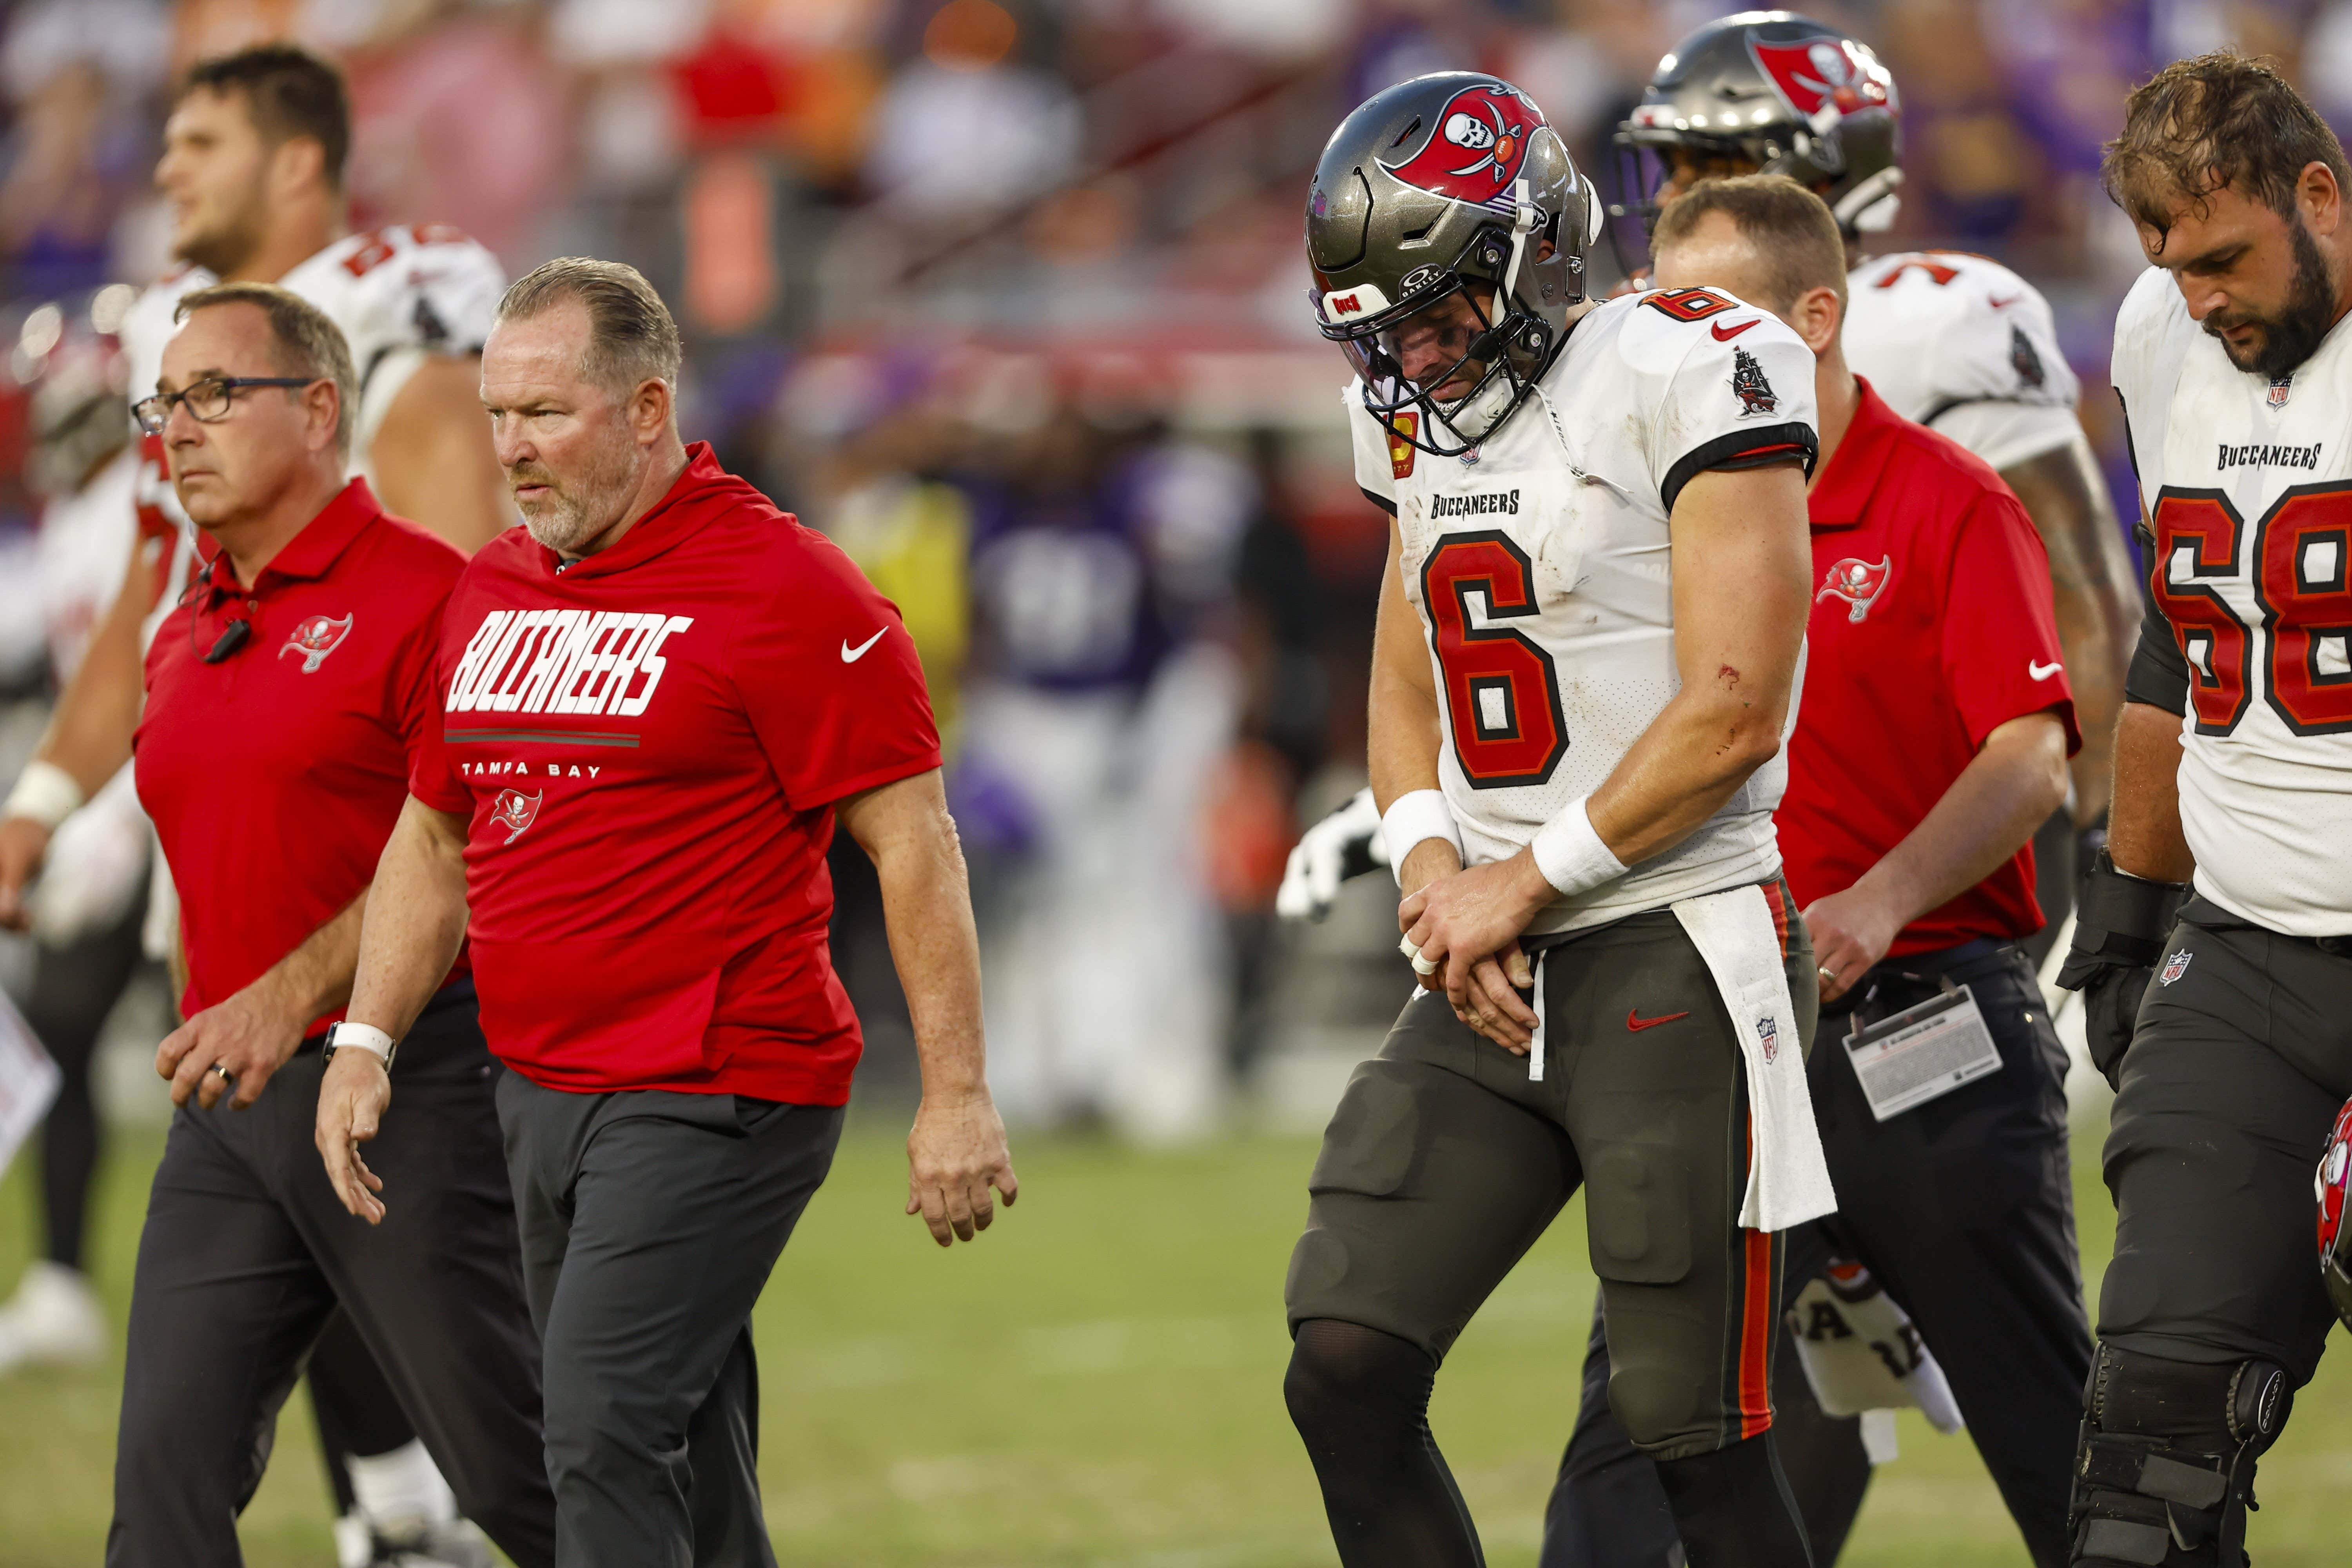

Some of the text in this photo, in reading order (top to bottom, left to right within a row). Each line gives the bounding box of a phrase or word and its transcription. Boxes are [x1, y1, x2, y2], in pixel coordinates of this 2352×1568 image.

[1402, 270, 1439, 298] OAKLEY
[1637, 285, 1740, 323] 6
[2269, 387, 2287, 403] NFL
[2217, 442, 2322, 472] BUCCANEERS
[1431, 489, 1519, 521] BUCCANEERS
[2152, 480, 2352, 737] 68
[444, 609, 695, 716] BUCCANEERS
[1420, 529, 1570, 789] 6
[461, 762, 601, 779] TAMPA BAY
[2164, 965, 2181, 979] NFL
